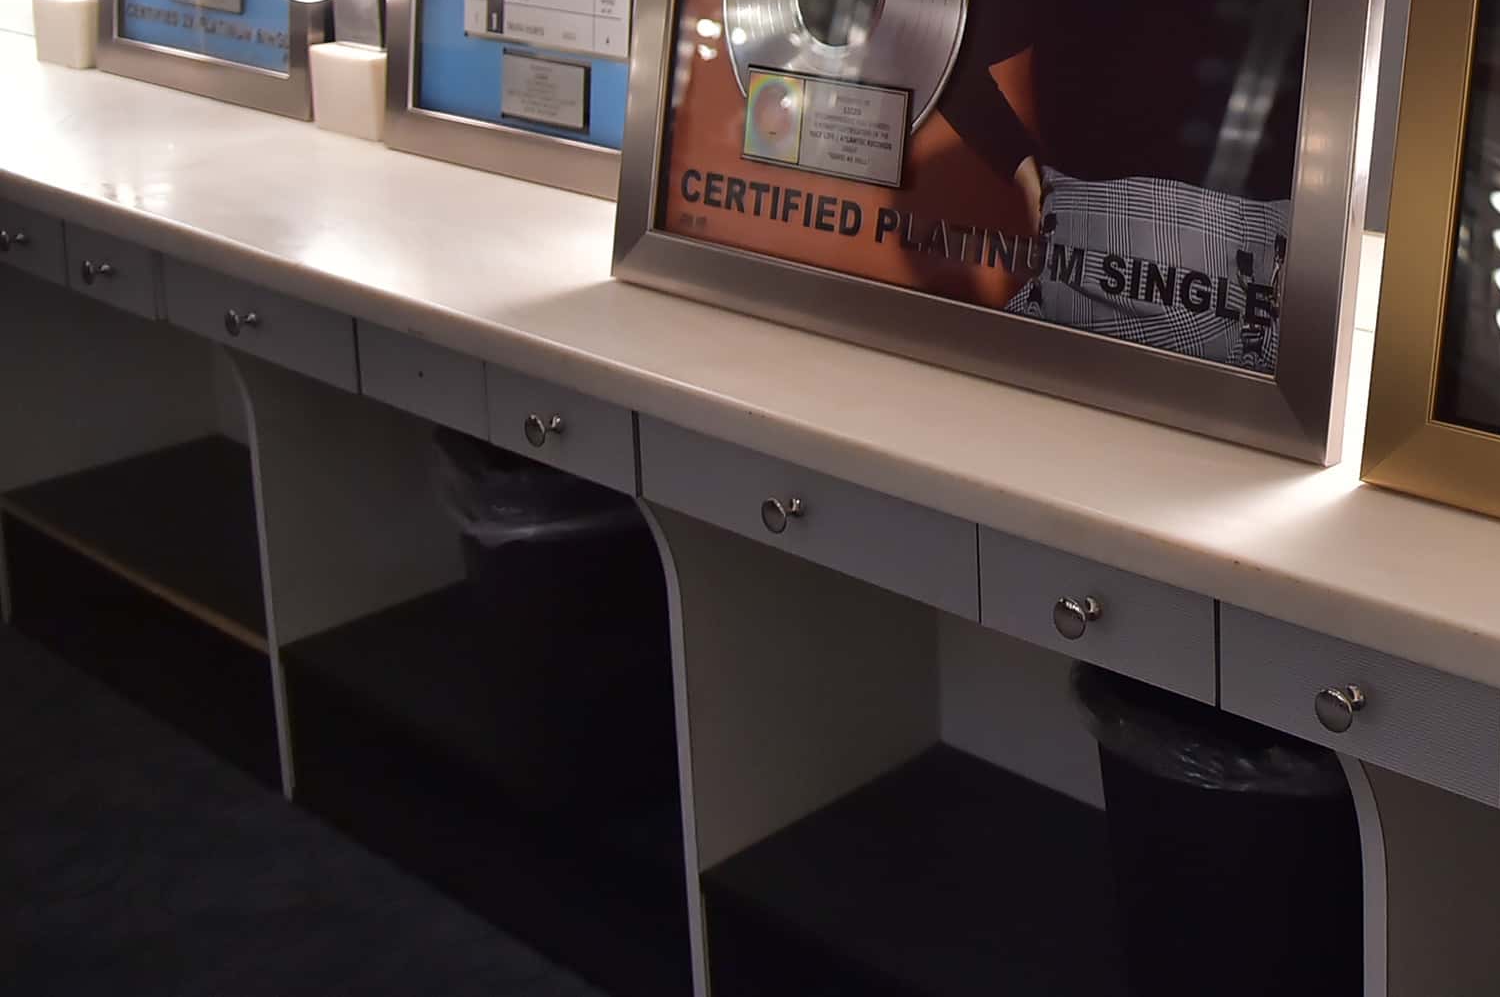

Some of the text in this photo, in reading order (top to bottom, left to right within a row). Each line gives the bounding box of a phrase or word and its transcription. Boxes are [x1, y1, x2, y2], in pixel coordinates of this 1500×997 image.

[680, 169, 1278, 328] CERTIFIED PLATINUM SINGLE
